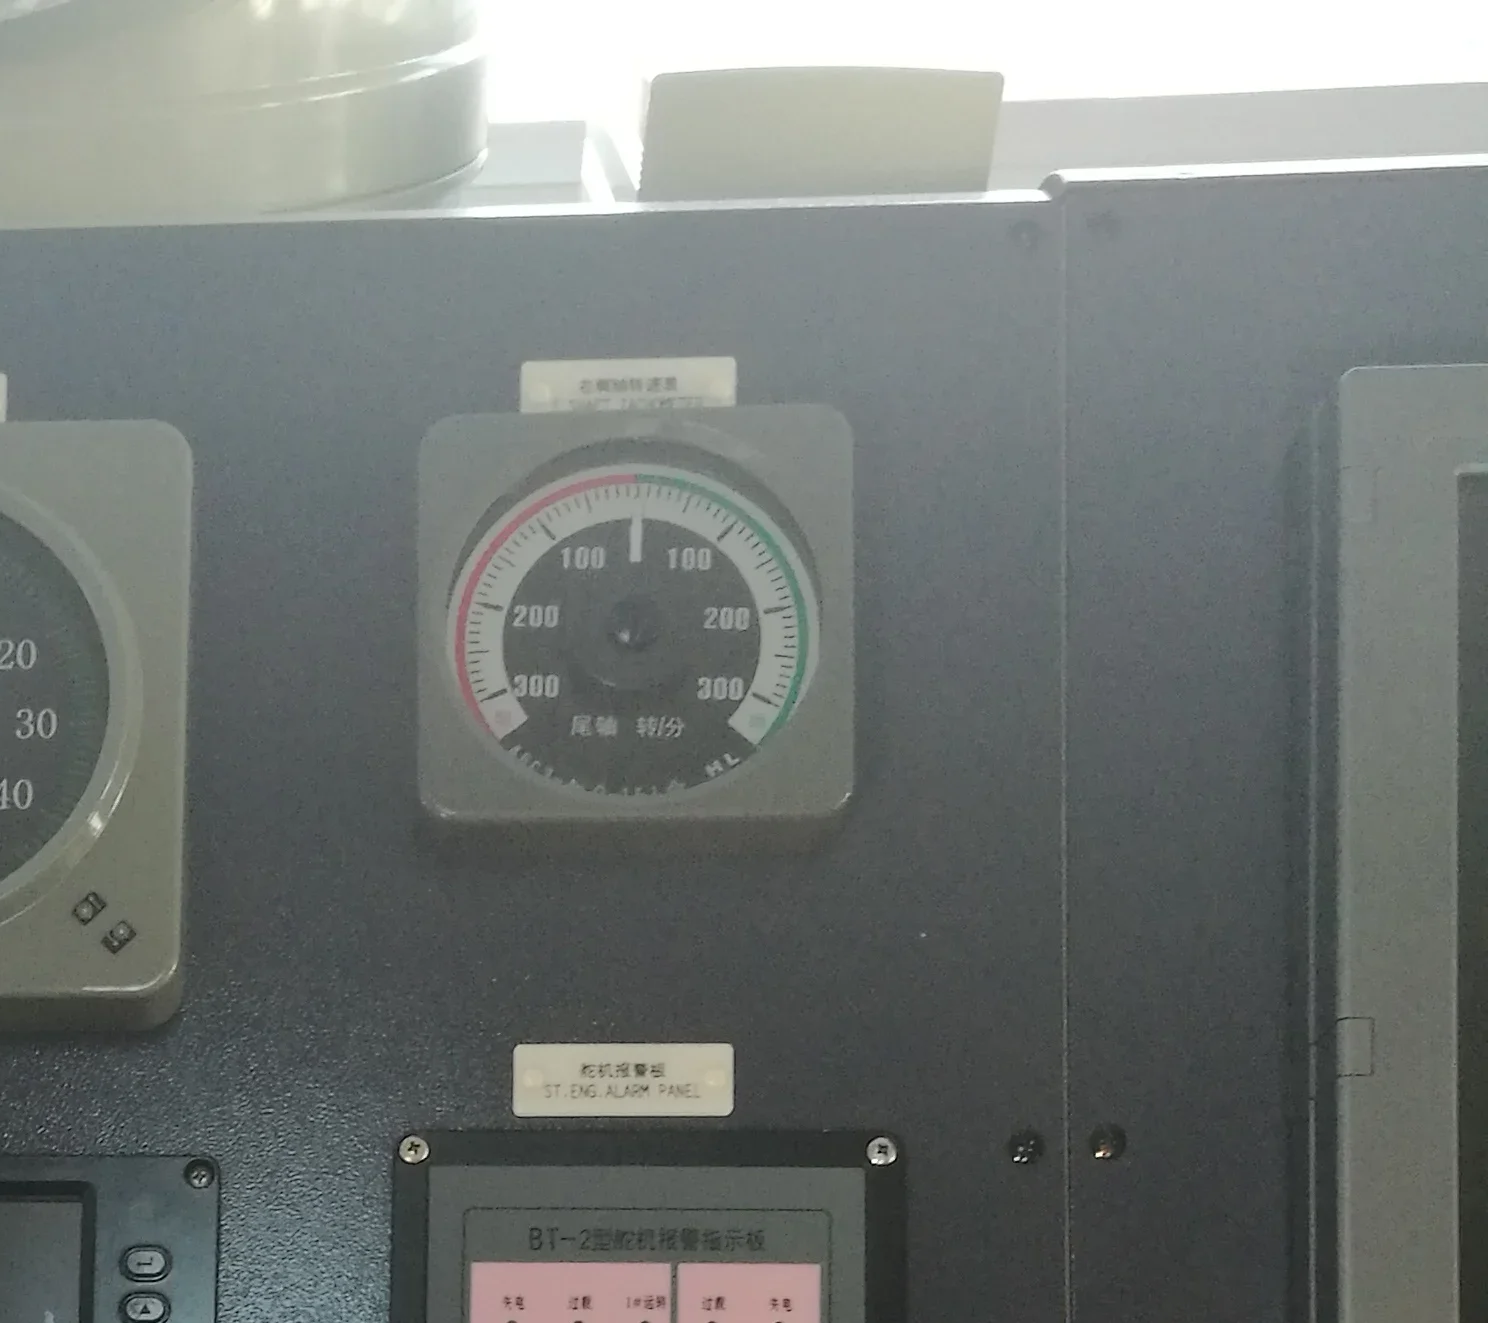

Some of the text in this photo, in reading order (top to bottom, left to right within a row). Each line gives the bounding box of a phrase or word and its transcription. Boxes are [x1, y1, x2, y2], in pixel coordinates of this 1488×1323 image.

[561, 547, 712, 570] 100 100
[513, 604, 751, 631] 200 200
[513, 674, 744, 700] 300 300
[15, 708, 59, 740] 30
